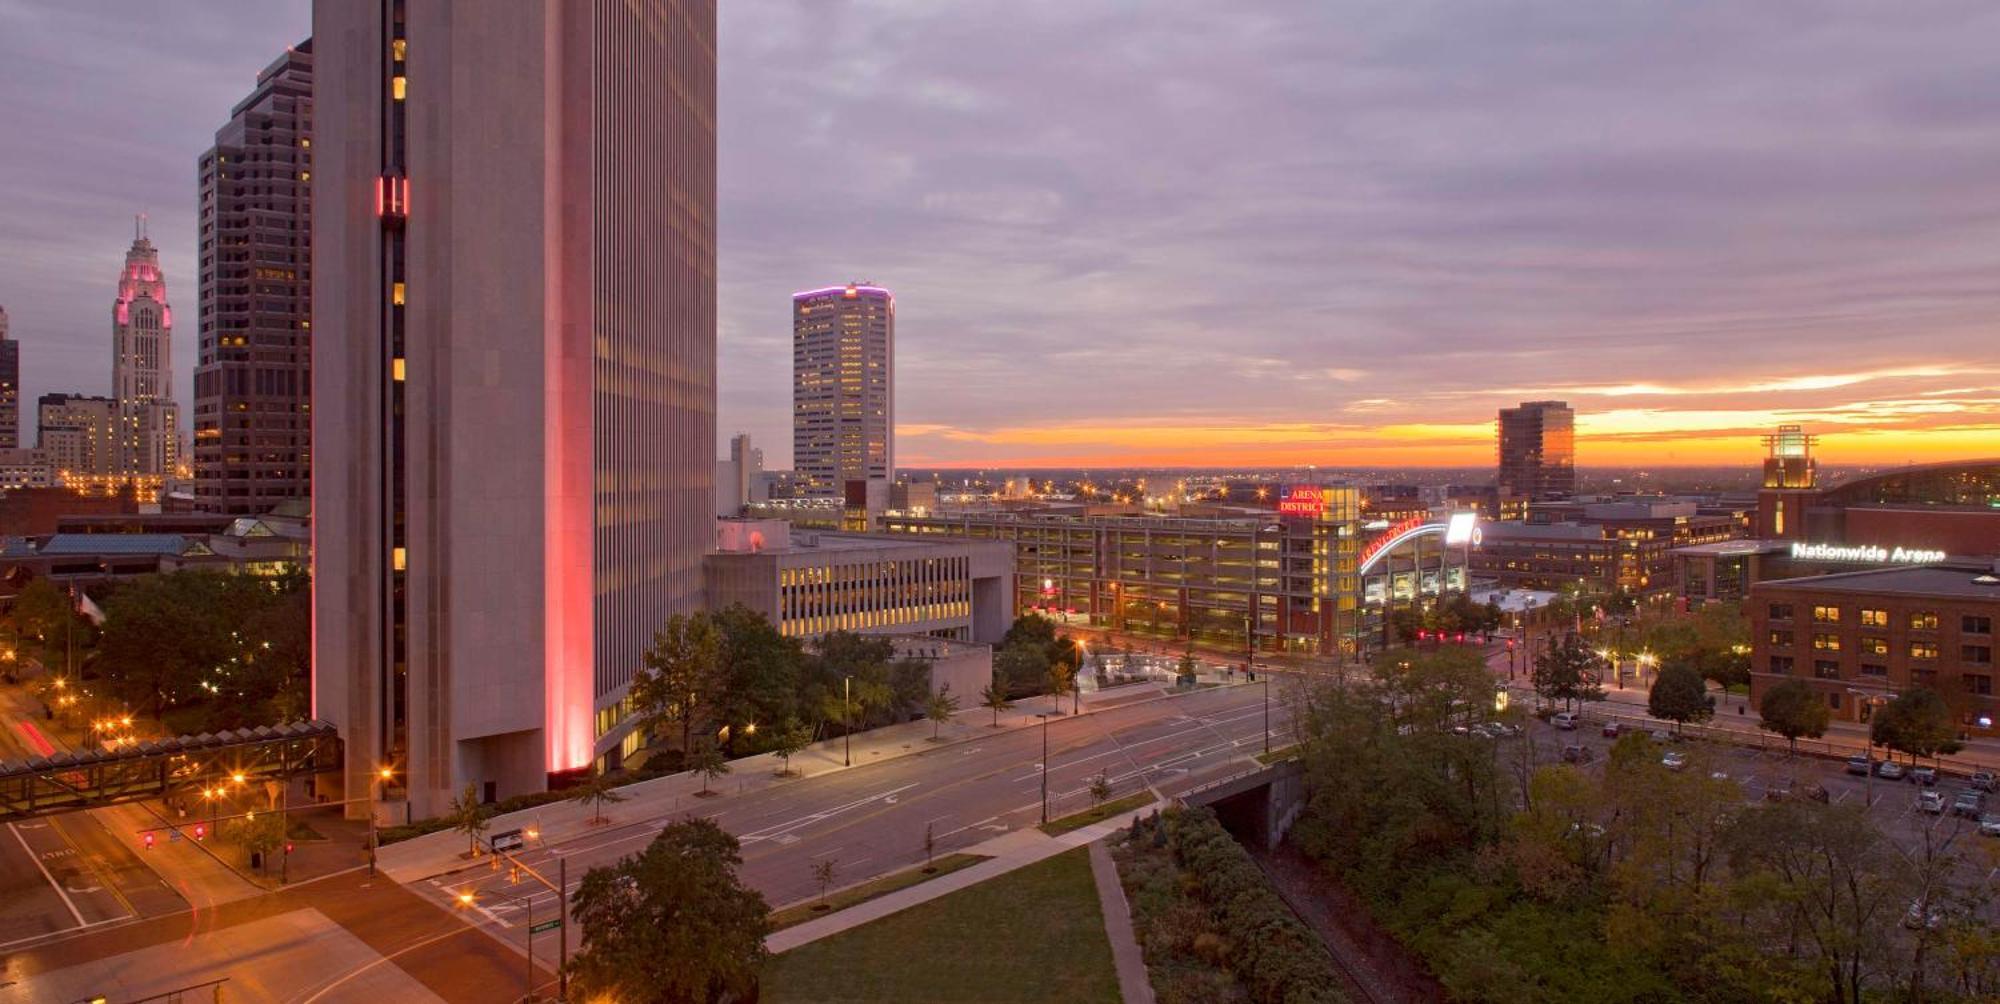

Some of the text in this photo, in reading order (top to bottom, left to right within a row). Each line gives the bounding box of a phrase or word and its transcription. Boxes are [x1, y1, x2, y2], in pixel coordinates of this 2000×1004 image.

[1292, 490, 1323, 499] ARENA
[1281, 502, 1323, 511] DISTRICT
[1792, 542, 1945, 563] Nationwide Arena
